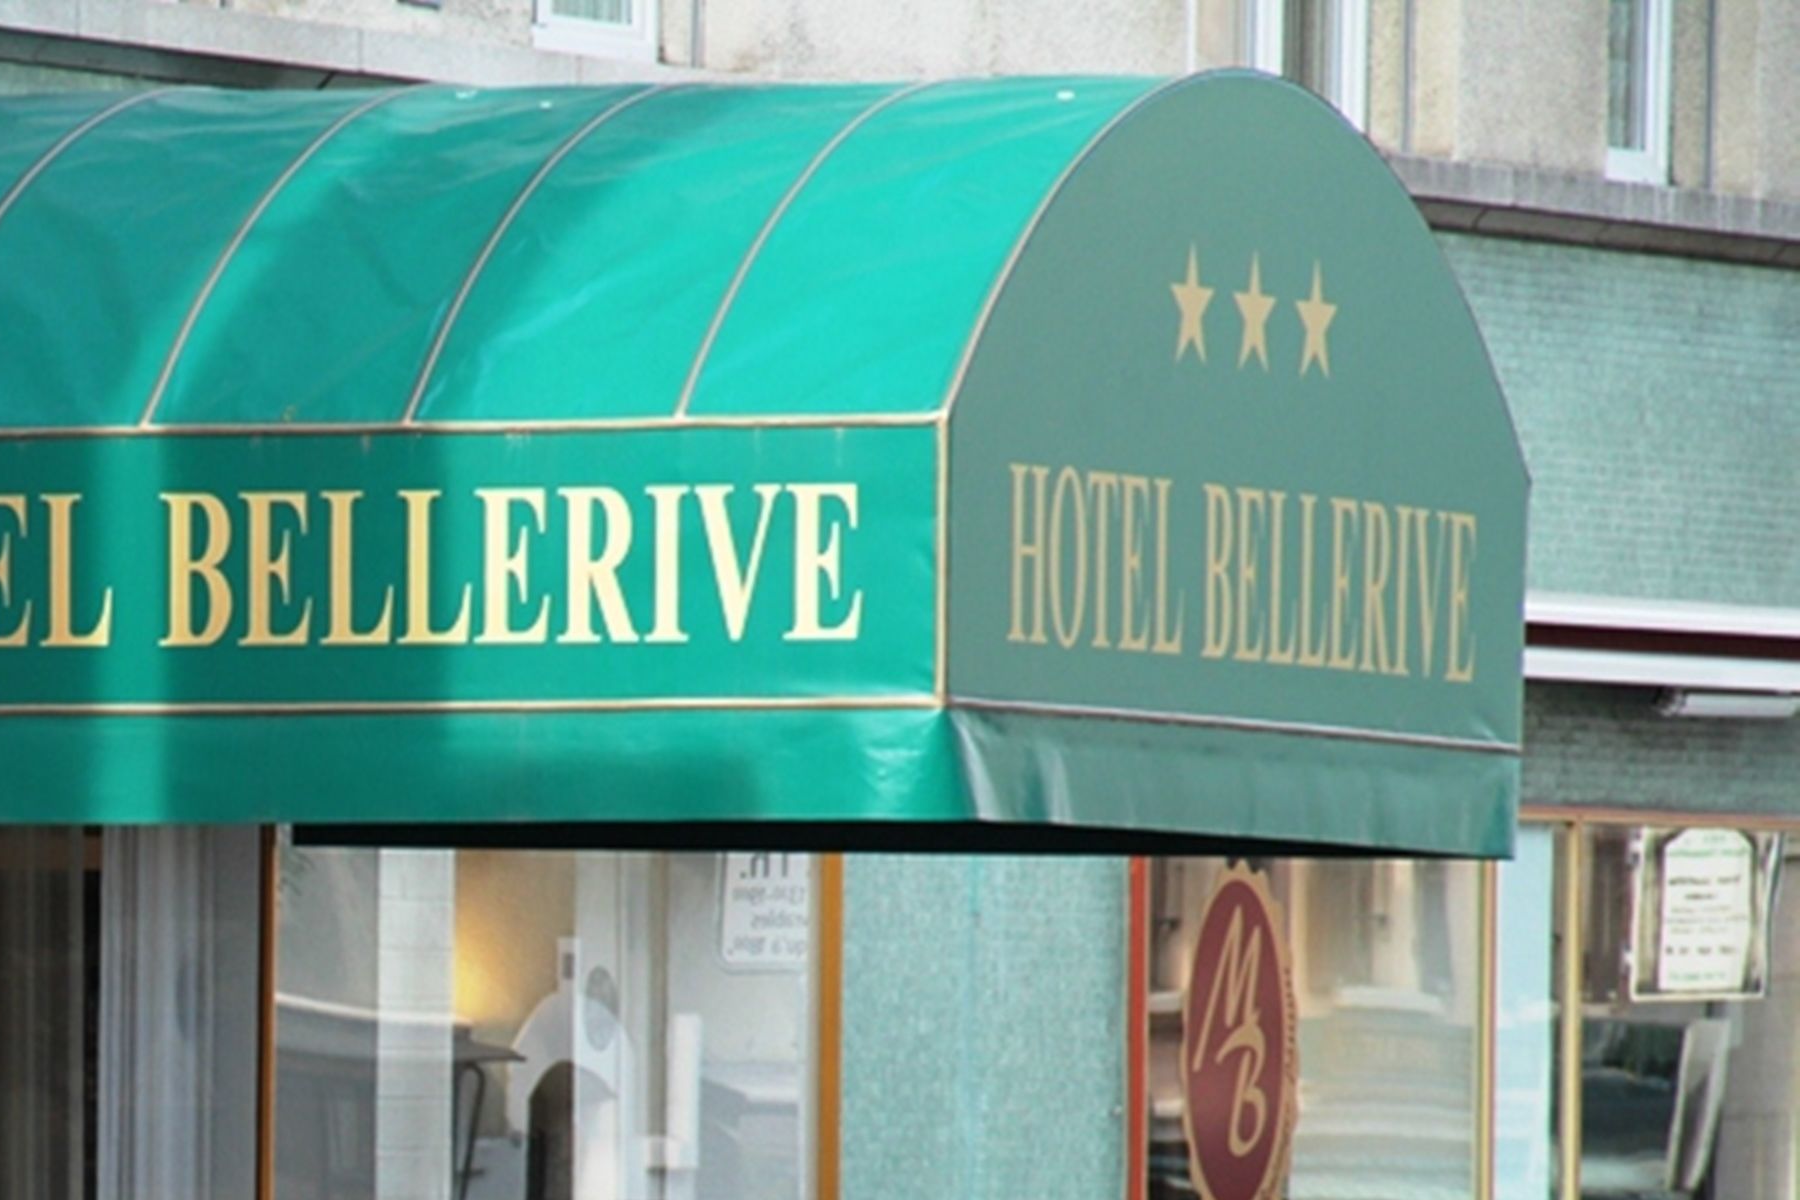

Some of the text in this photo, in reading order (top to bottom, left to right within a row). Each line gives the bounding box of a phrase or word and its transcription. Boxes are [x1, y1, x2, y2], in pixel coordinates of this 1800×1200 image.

[158, 482, 864, 648] BELLERIVE
[1006, 462, 1478, 684] HOTEL BELLERIVE
